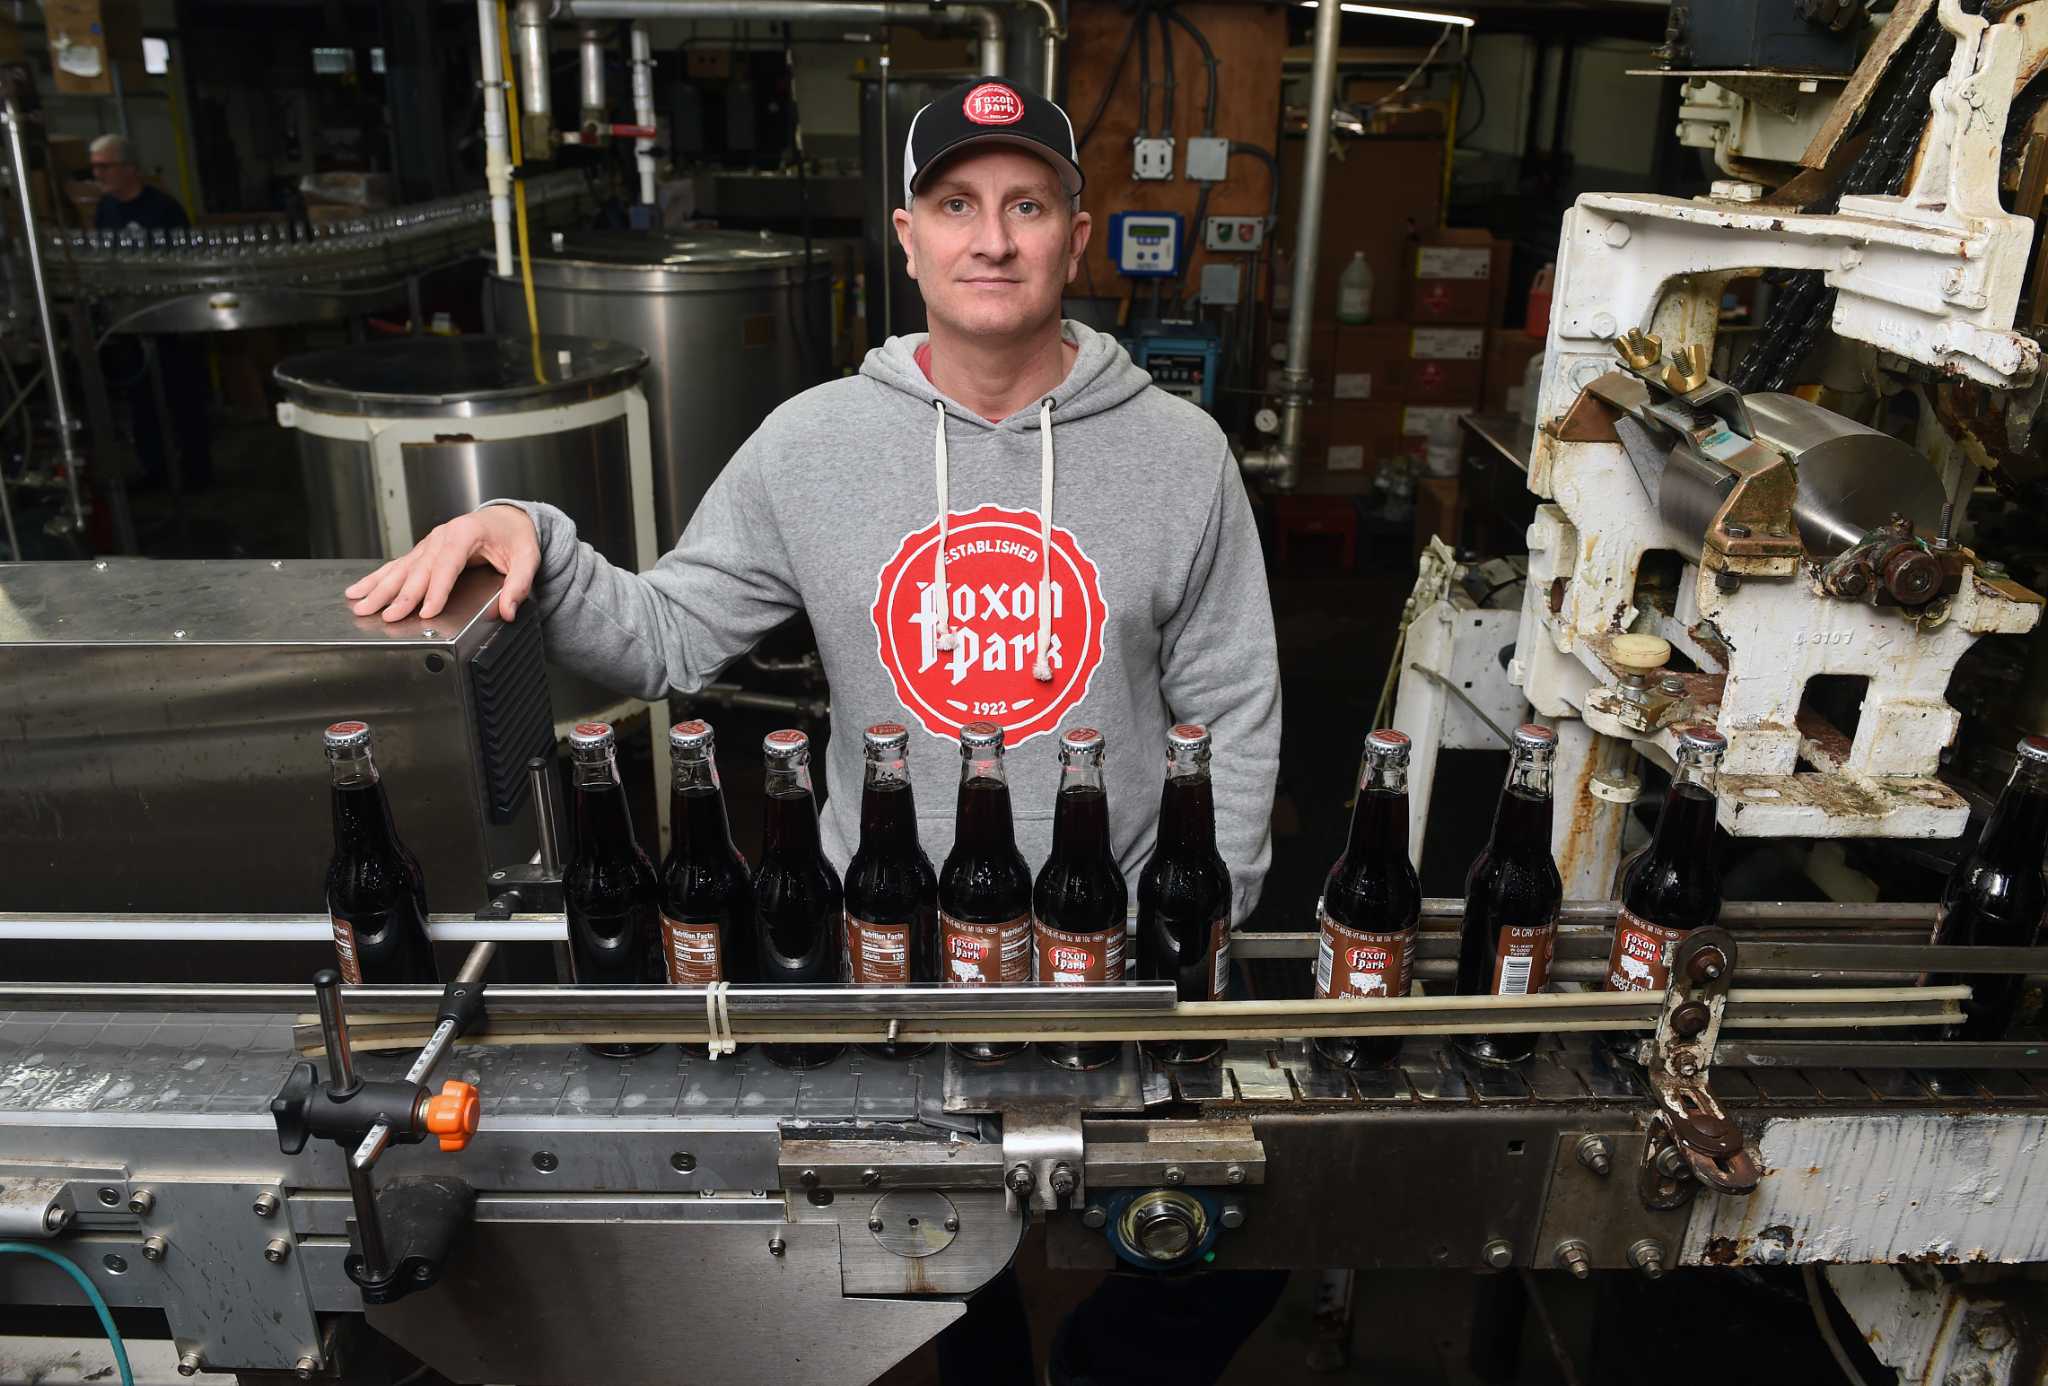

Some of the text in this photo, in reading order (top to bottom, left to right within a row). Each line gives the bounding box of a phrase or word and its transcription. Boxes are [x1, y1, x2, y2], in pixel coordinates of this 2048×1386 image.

[972, 95, 1014, 114] Foxon
[984, 103, 1015, 115] Park
[943, 539, 1039, 566] ESTABLISHED
[972, 700, 1008, 716] 1922
[1511, 927, 1520, 937] CA
[1521, 928, 1535, 937] CRV
[703, 952, 716, 960] 130
[892, 952, 905, 960] 130
[956, 947, 979, 960] Park
[1628, 943, 1653, 960] Park
[1060, 959, 1086, 970] Park
[1358, 959, 1385, 970] Park
